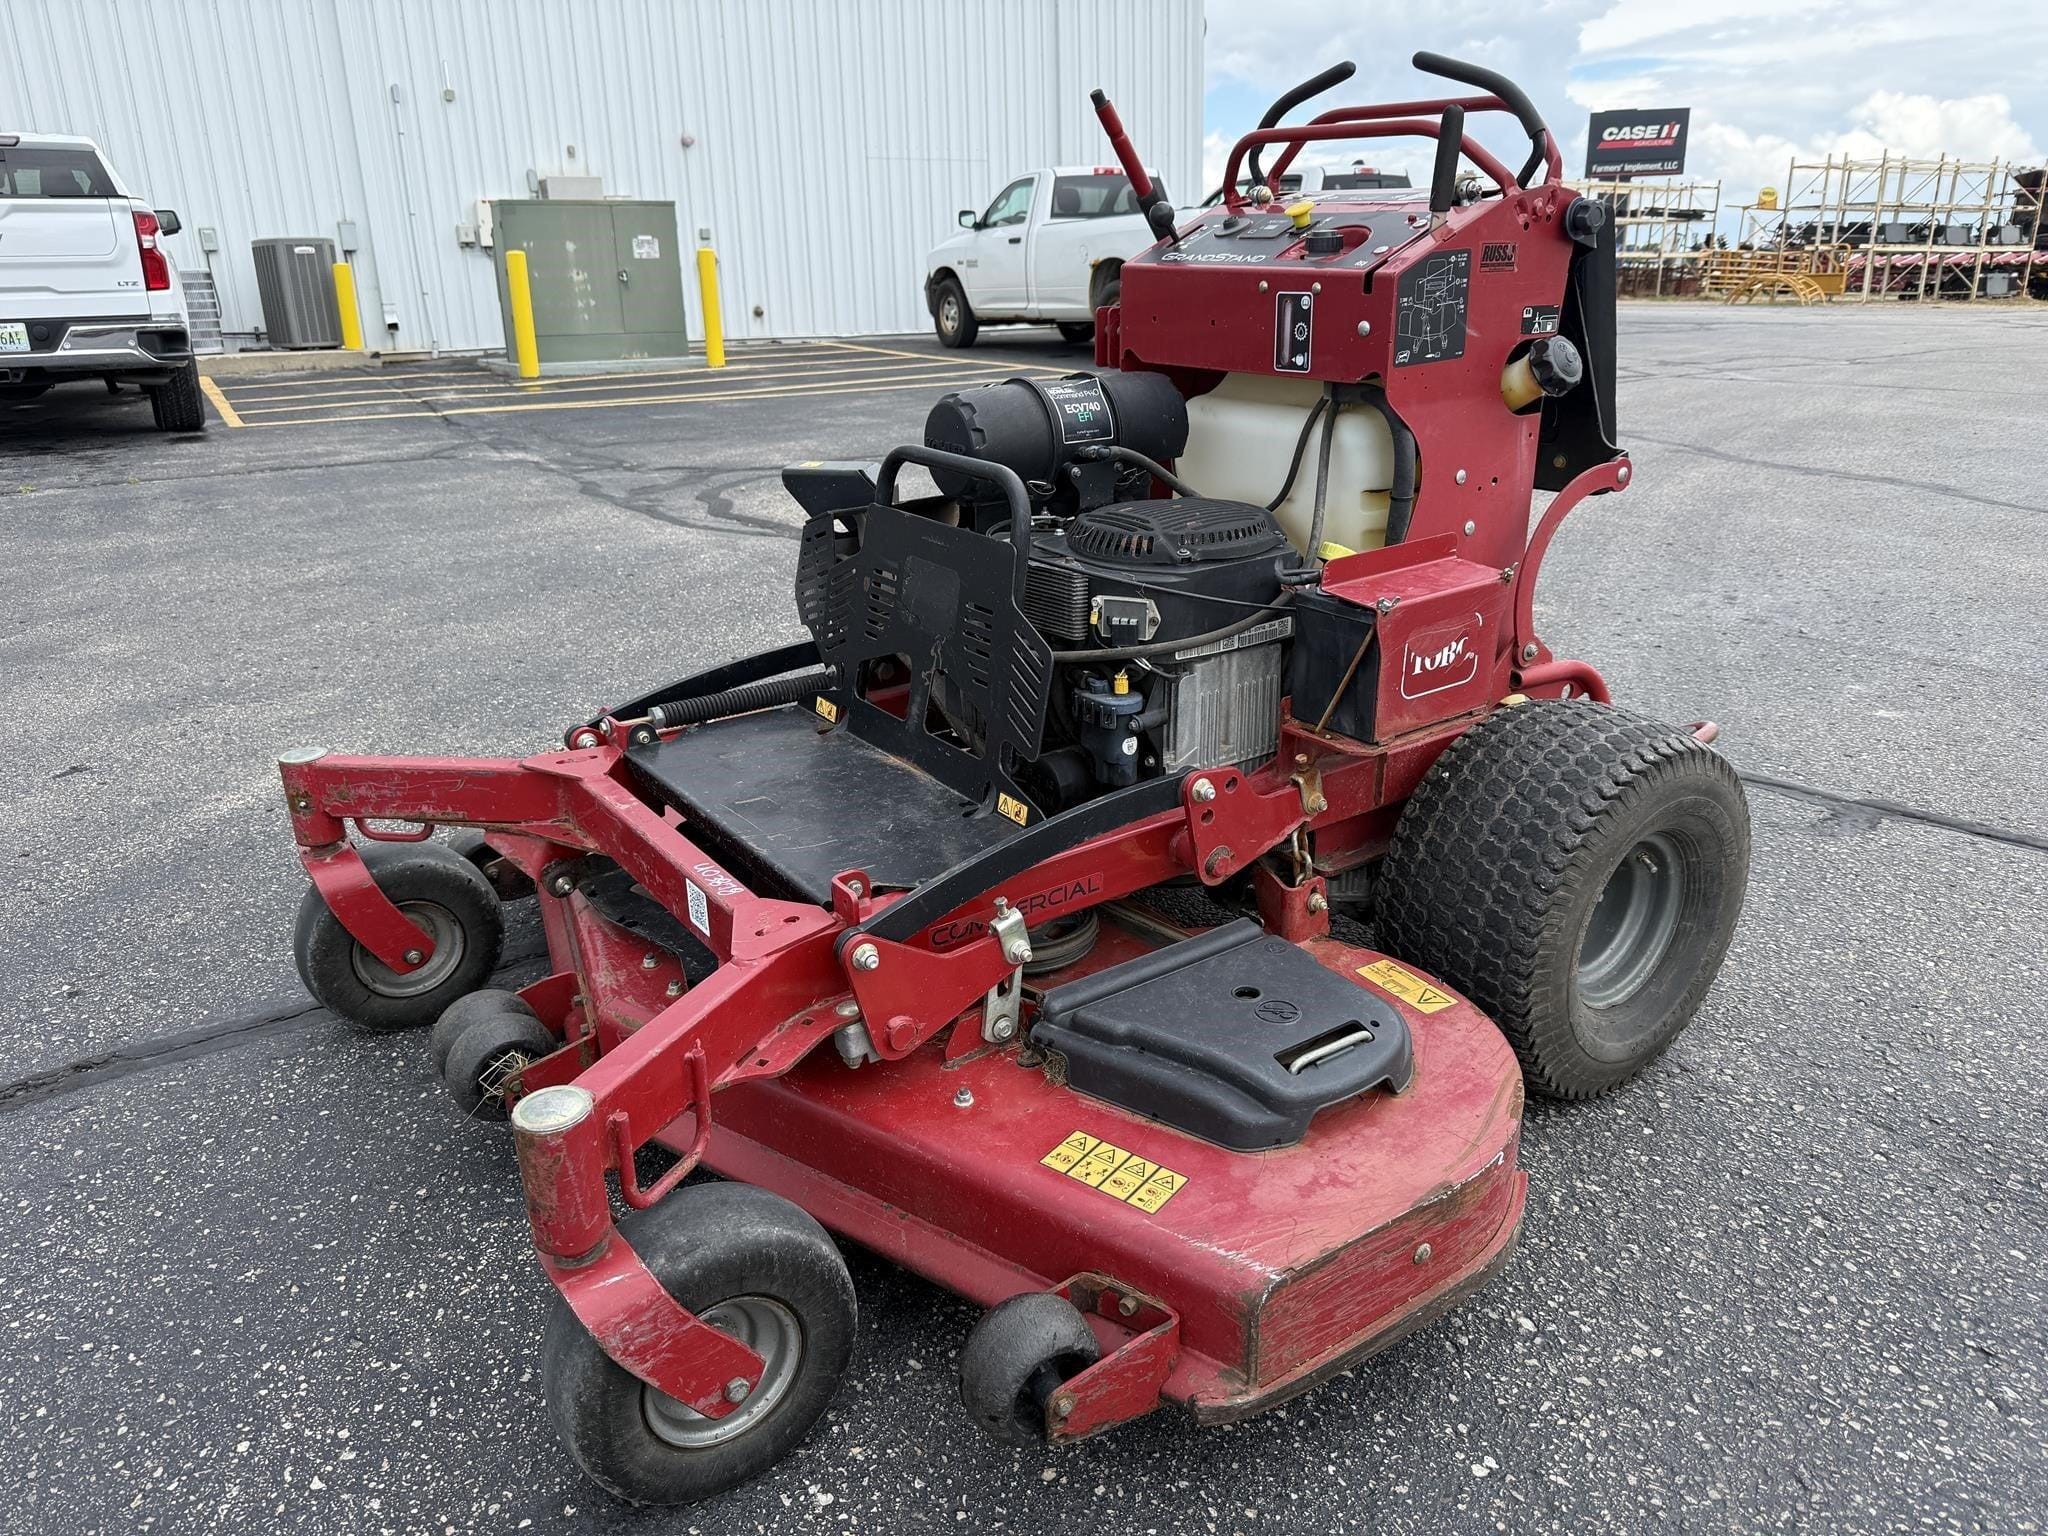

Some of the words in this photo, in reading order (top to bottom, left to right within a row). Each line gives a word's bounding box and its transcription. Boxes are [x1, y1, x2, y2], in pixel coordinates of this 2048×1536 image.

[1602, 124, 1660, 141] CASE
[1664, 160, 1679, 170] LLC
[1064, 402, 1101, 414] ECV740
[1078, 412, 1093, 423] EFI
[931, 877, 1101, 945] COMERCIAL
